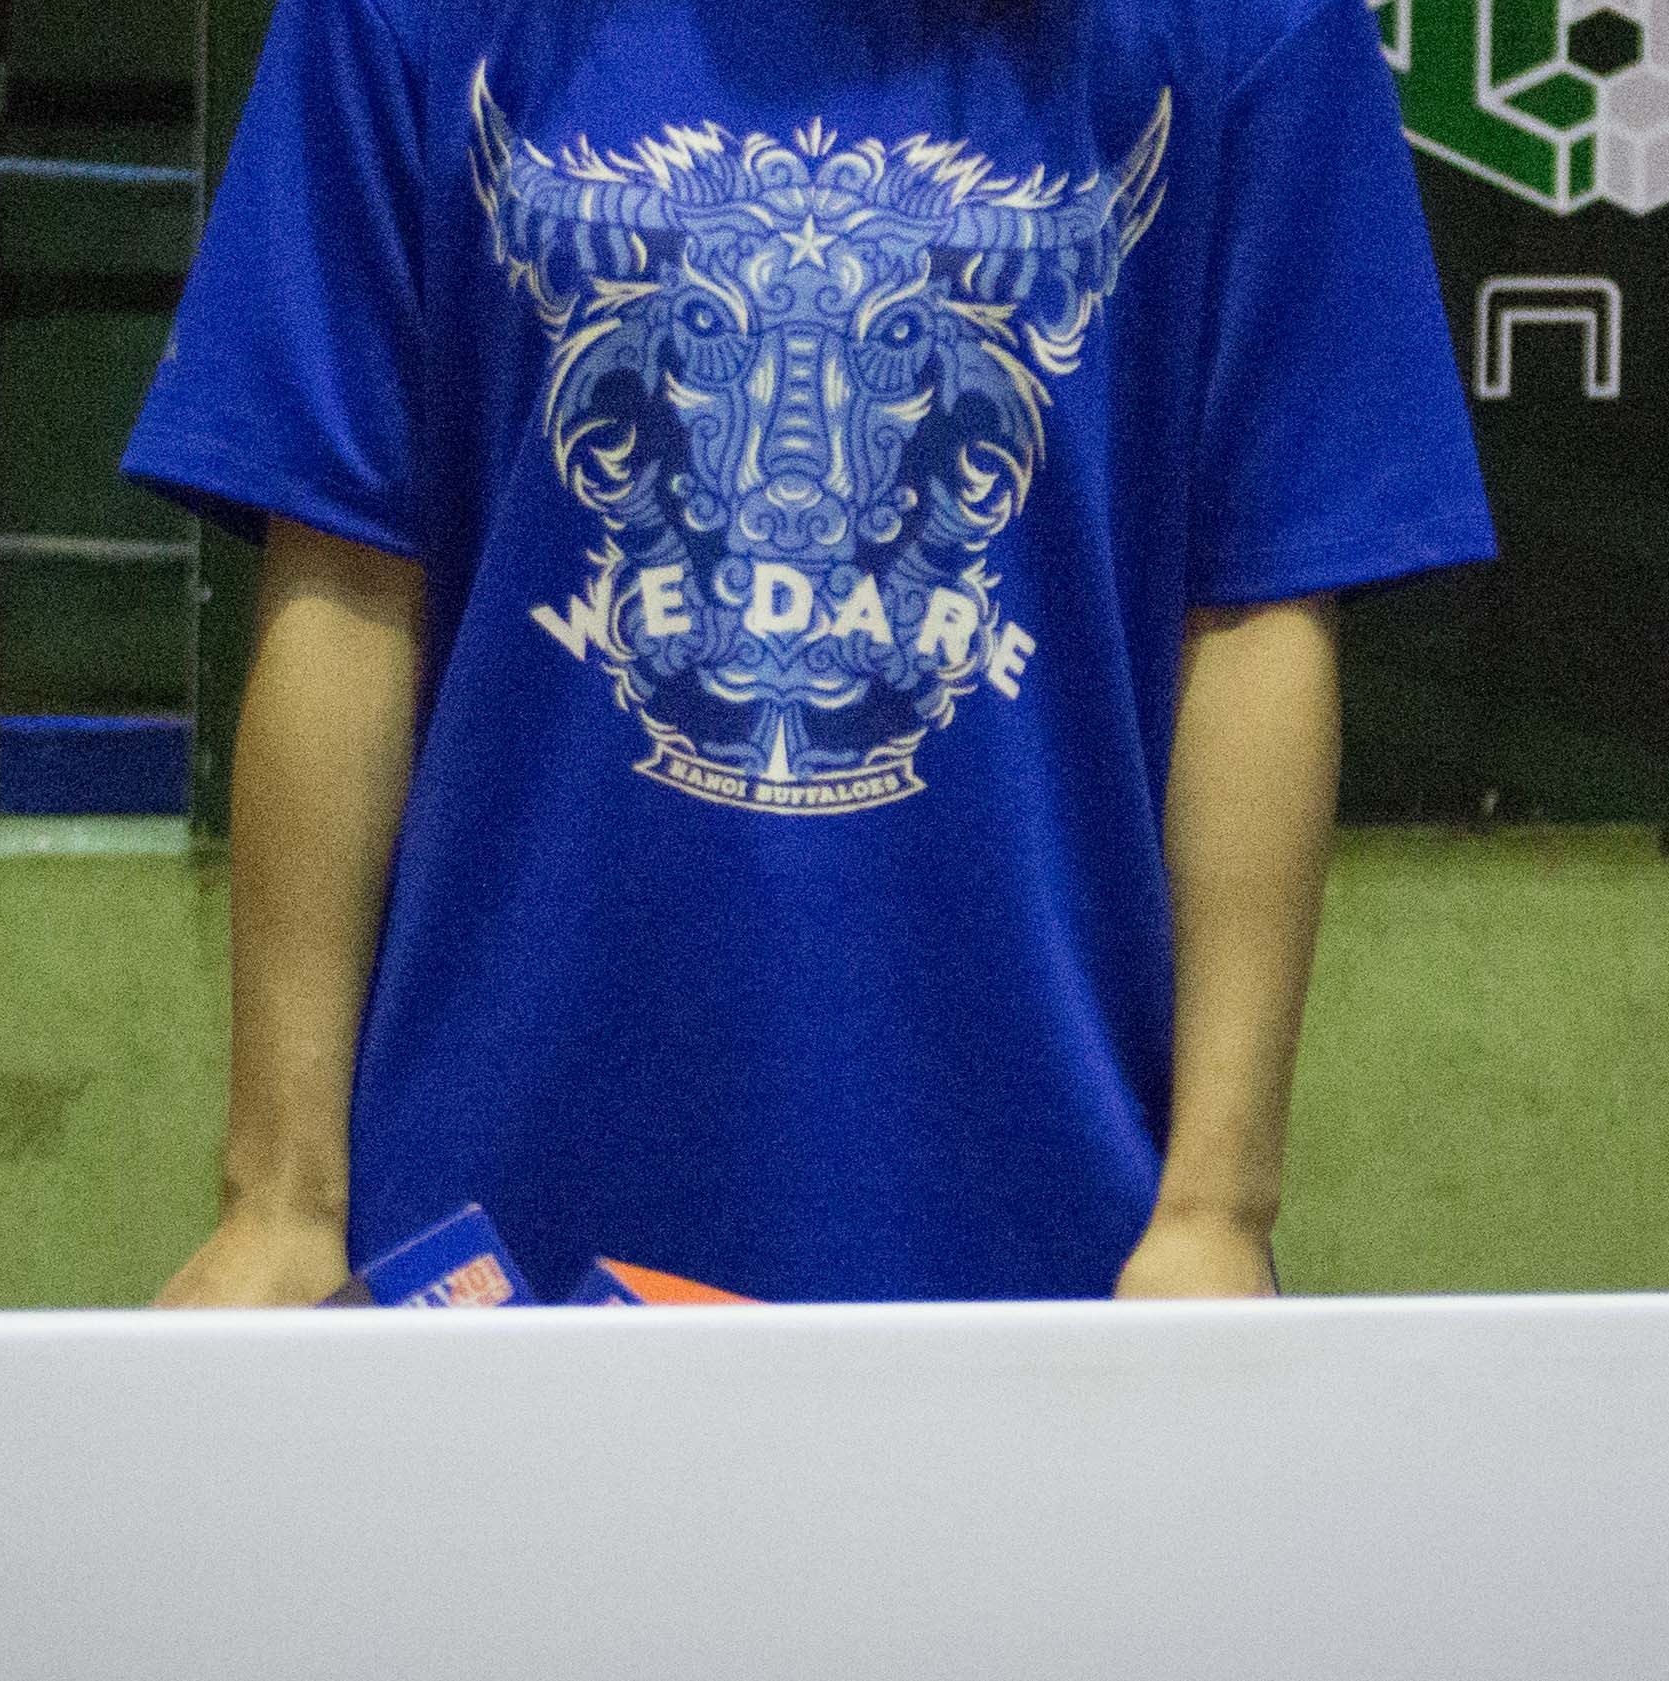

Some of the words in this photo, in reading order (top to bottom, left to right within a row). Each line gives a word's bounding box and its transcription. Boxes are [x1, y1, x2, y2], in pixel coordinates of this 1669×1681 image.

[531, 564, 692, 661] WE
[752, 563, 1037, 700] DARE
[669, 758, 747, 799] HANOI
[756, 773, 900, 804] BUFFALOES
